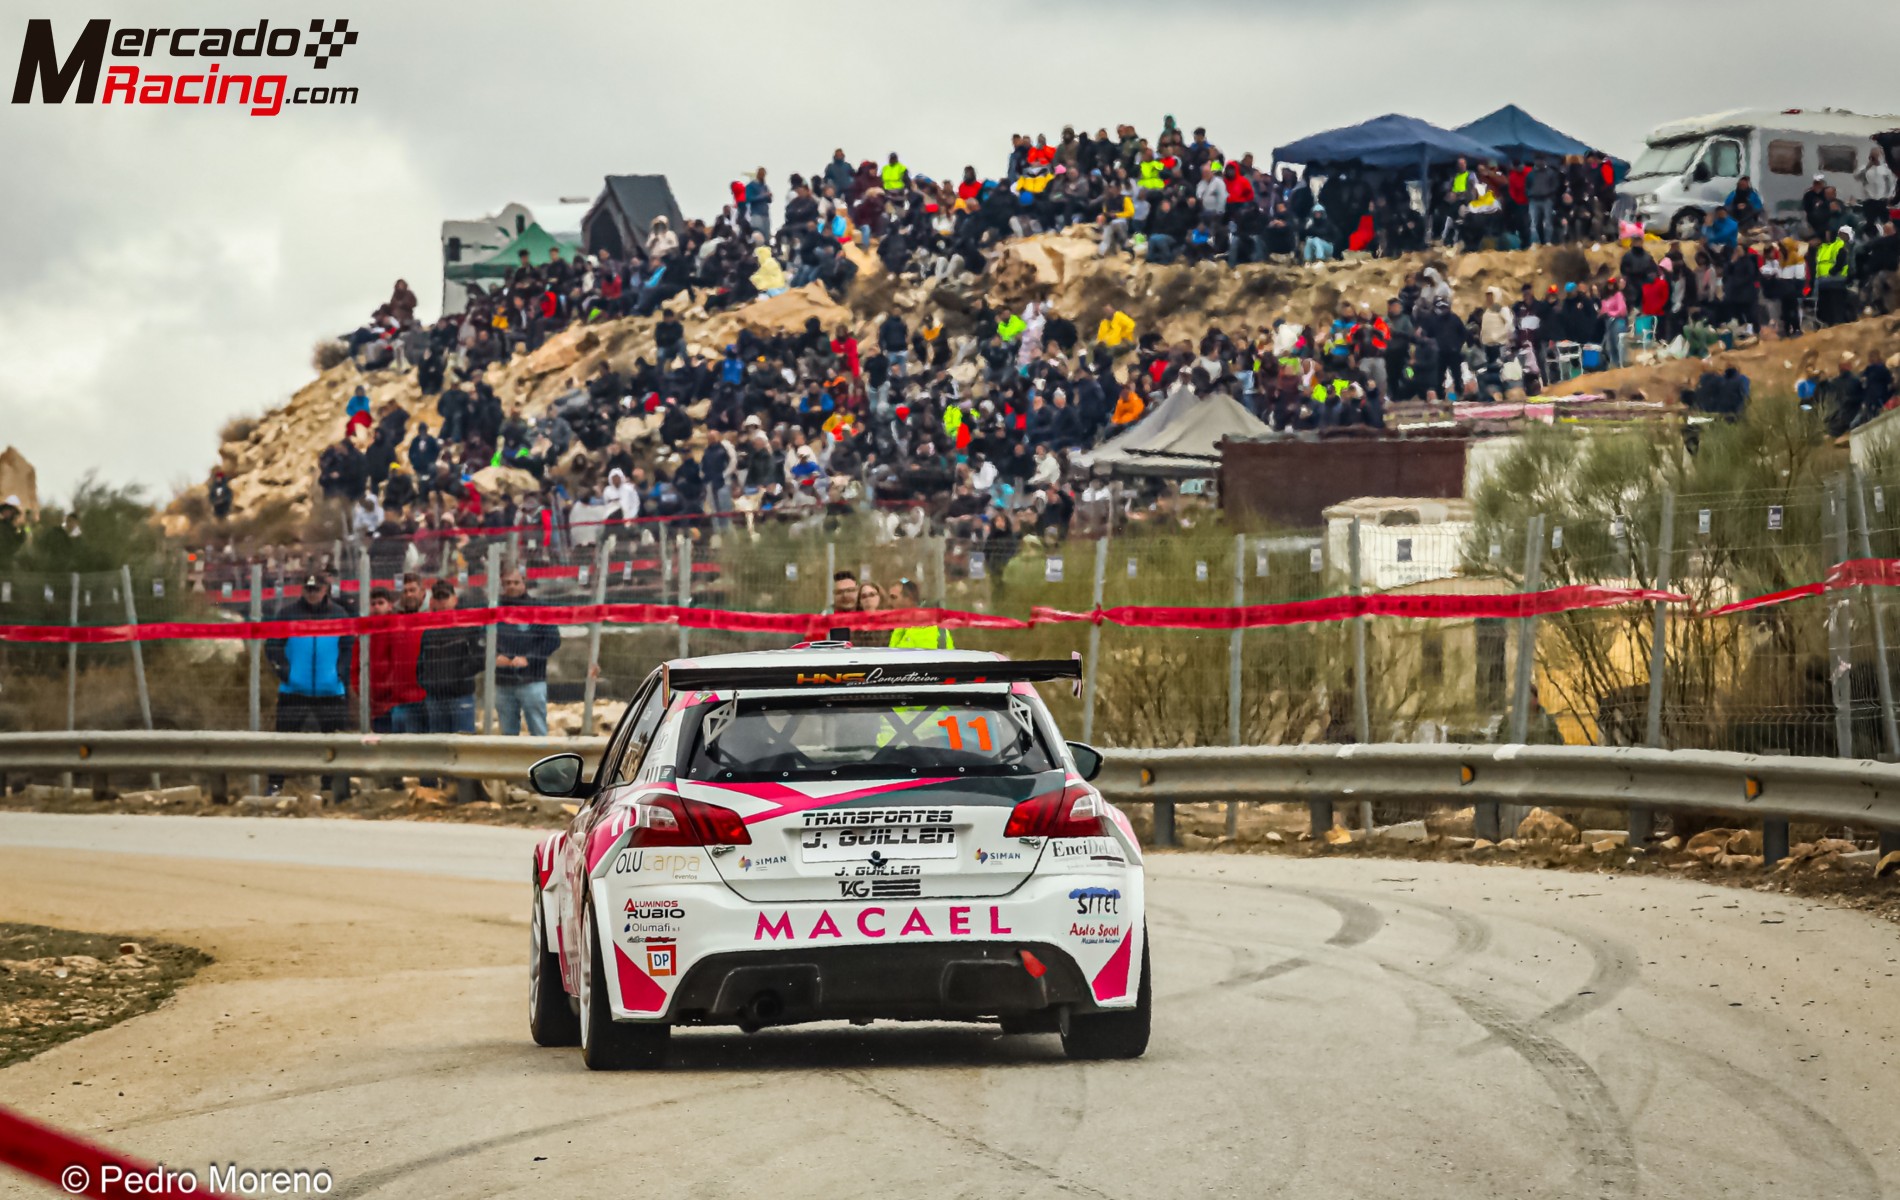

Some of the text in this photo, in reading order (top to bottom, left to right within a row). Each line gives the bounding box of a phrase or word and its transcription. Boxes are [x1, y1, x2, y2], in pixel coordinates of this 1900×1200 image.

[796, 672, 866, 685] HNS
[938, 715, 993, 751] 11
[802, 810, 953, 827] TRANSPORTES
[802, 828, 955, 849] J. GUILLEN
[755, 855, 788, 866] SIMAN
[990, 852, 1021, 860] SIMAN
[834, 865, 921, 877] J. GUILLEN
[838, 880, 870, 898] TAG
[1077, 892, 1119, 915] SITEL
[627, 908, 685, 919] RUBIO
[632, 923, 670, 932] Olumafi
[754, 906, 1012, 940] MACAEL
[653, 953, 669, 966] DP
